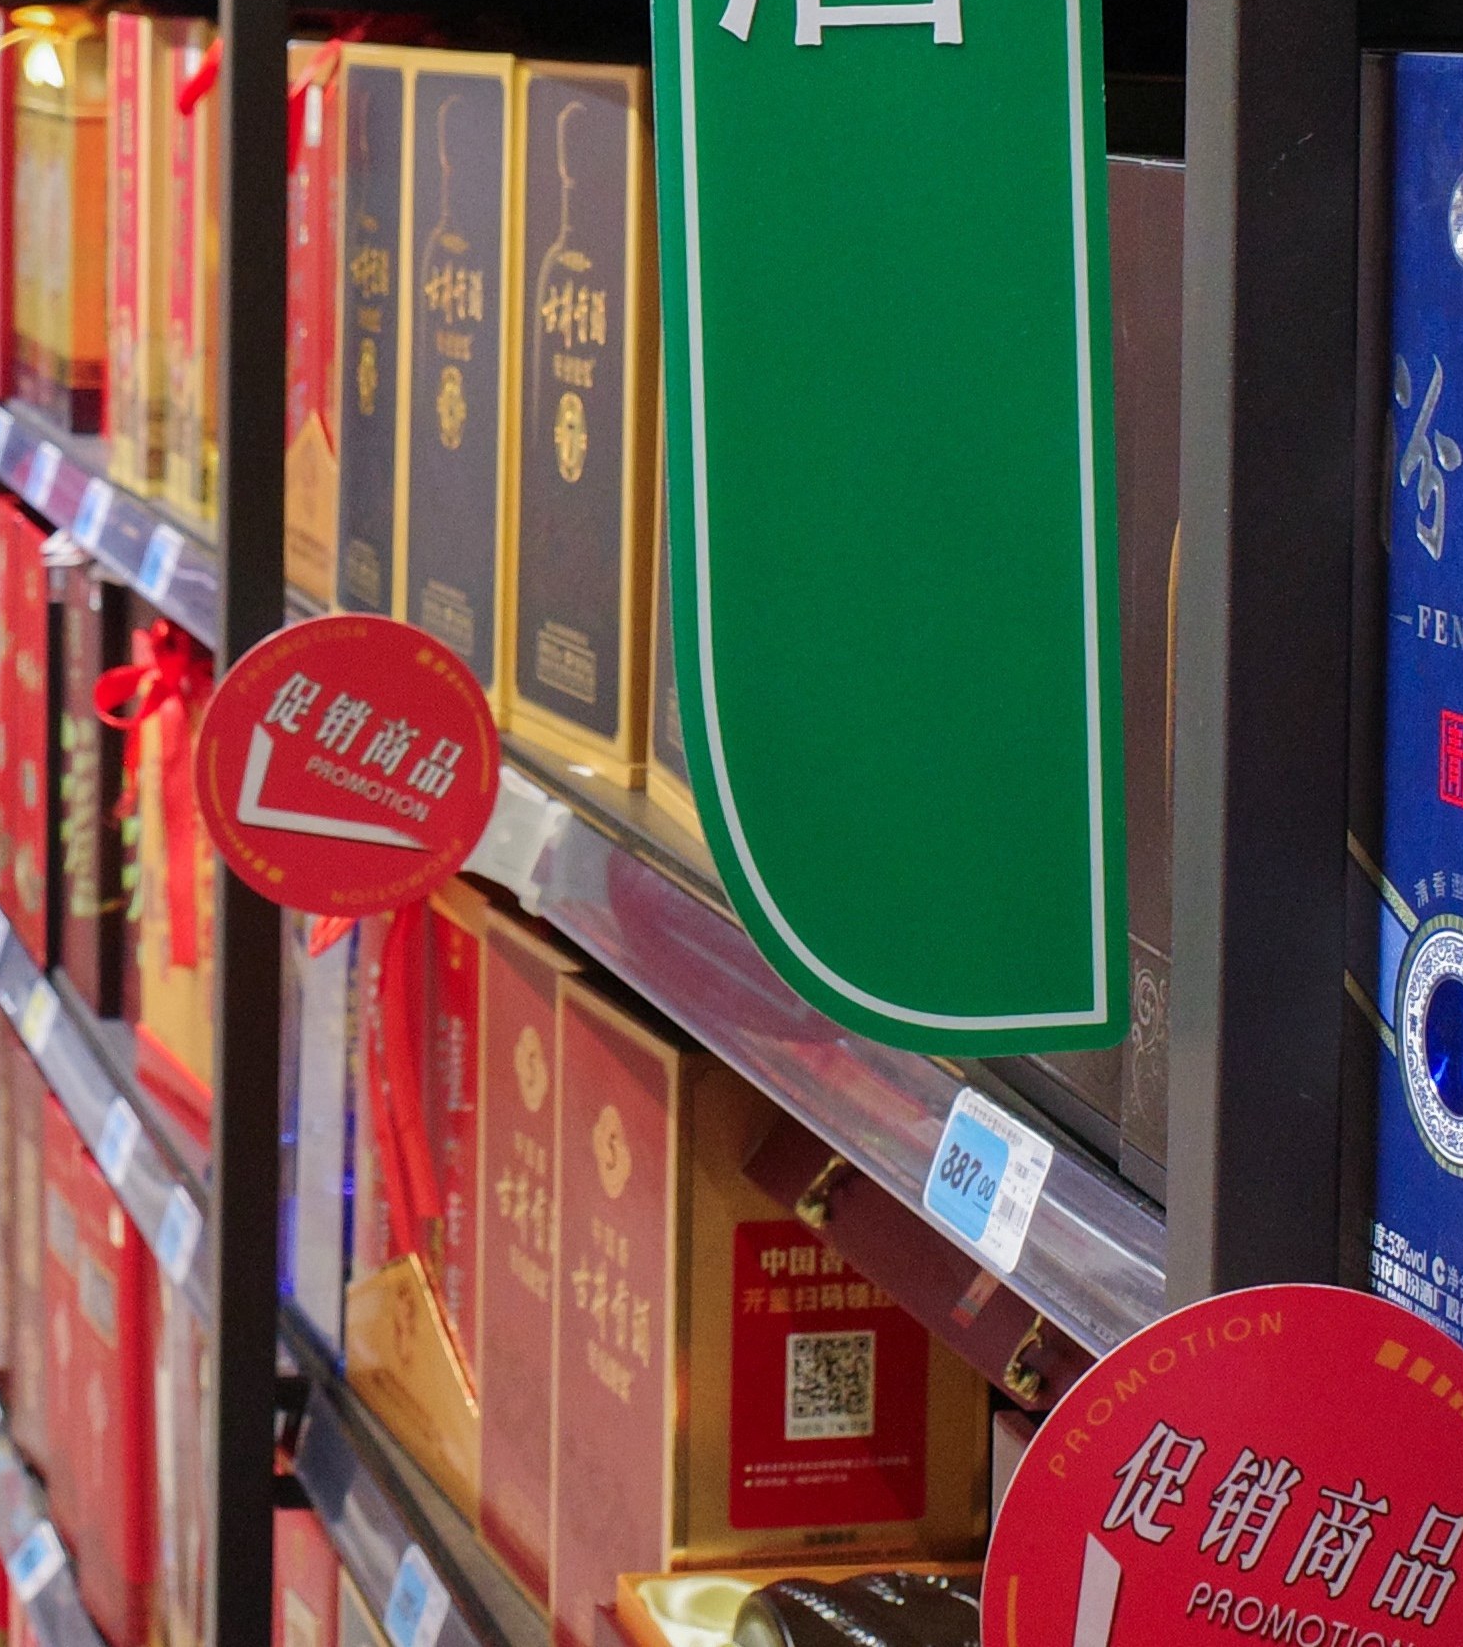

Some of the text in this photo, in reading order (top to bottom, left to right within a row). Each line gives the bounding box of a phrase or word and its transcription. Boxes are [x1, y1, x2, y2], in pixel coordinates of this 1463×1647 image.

[263, 670, 465, 801] 促销商品
[304, 754, 433, 824] PROMOTION
[1373, 1220, 1427, 1275] 度:53%vol
[1047, 1310, 1286, 1480] PROMOTION
[1186, 1582, 1415, 1647] PROMOTI
